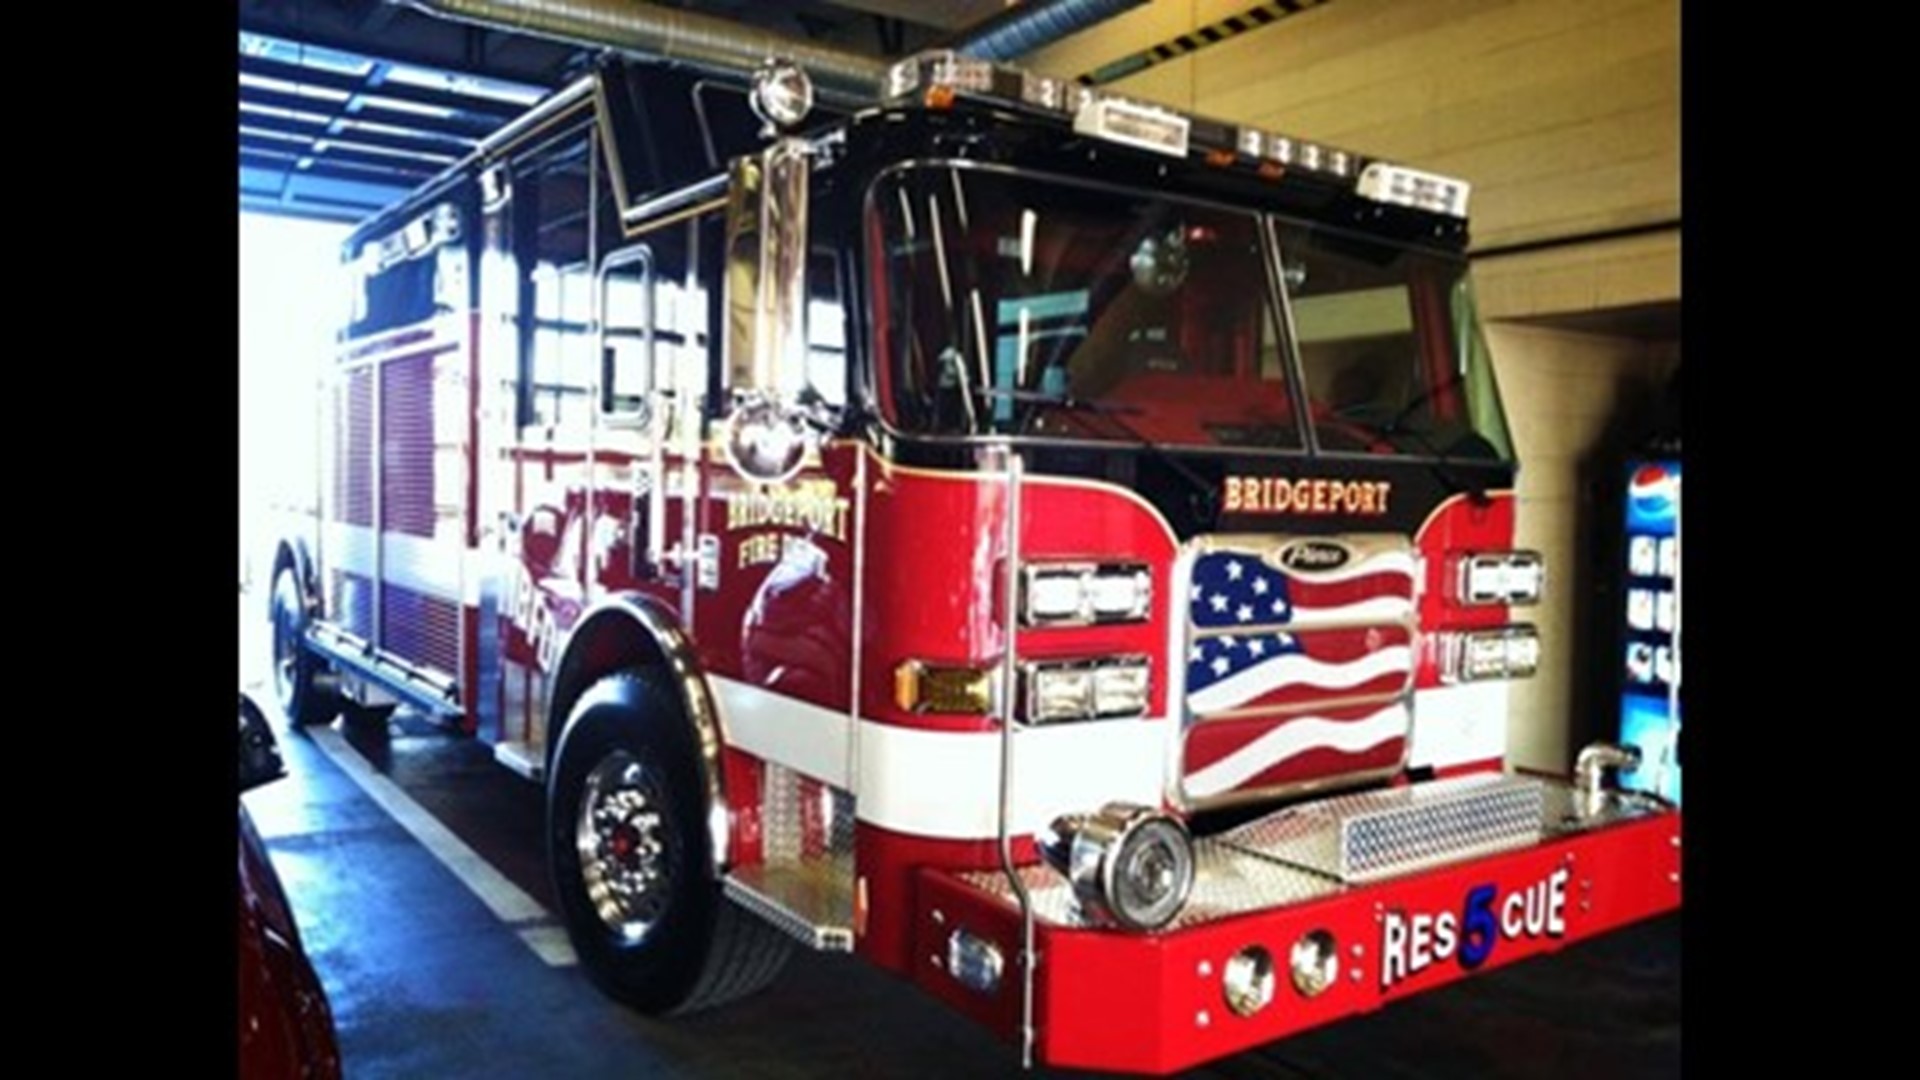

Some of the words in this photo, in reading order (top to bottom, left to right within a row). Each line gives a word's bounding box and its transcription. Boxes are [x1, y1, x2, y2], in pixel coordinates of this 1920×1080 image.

[1224, 476, 1391, 513] BRIDGEPORT
[727, 490, 849, 542] BRIDGEPORT
[738, 532, 779, 569] FIRE
